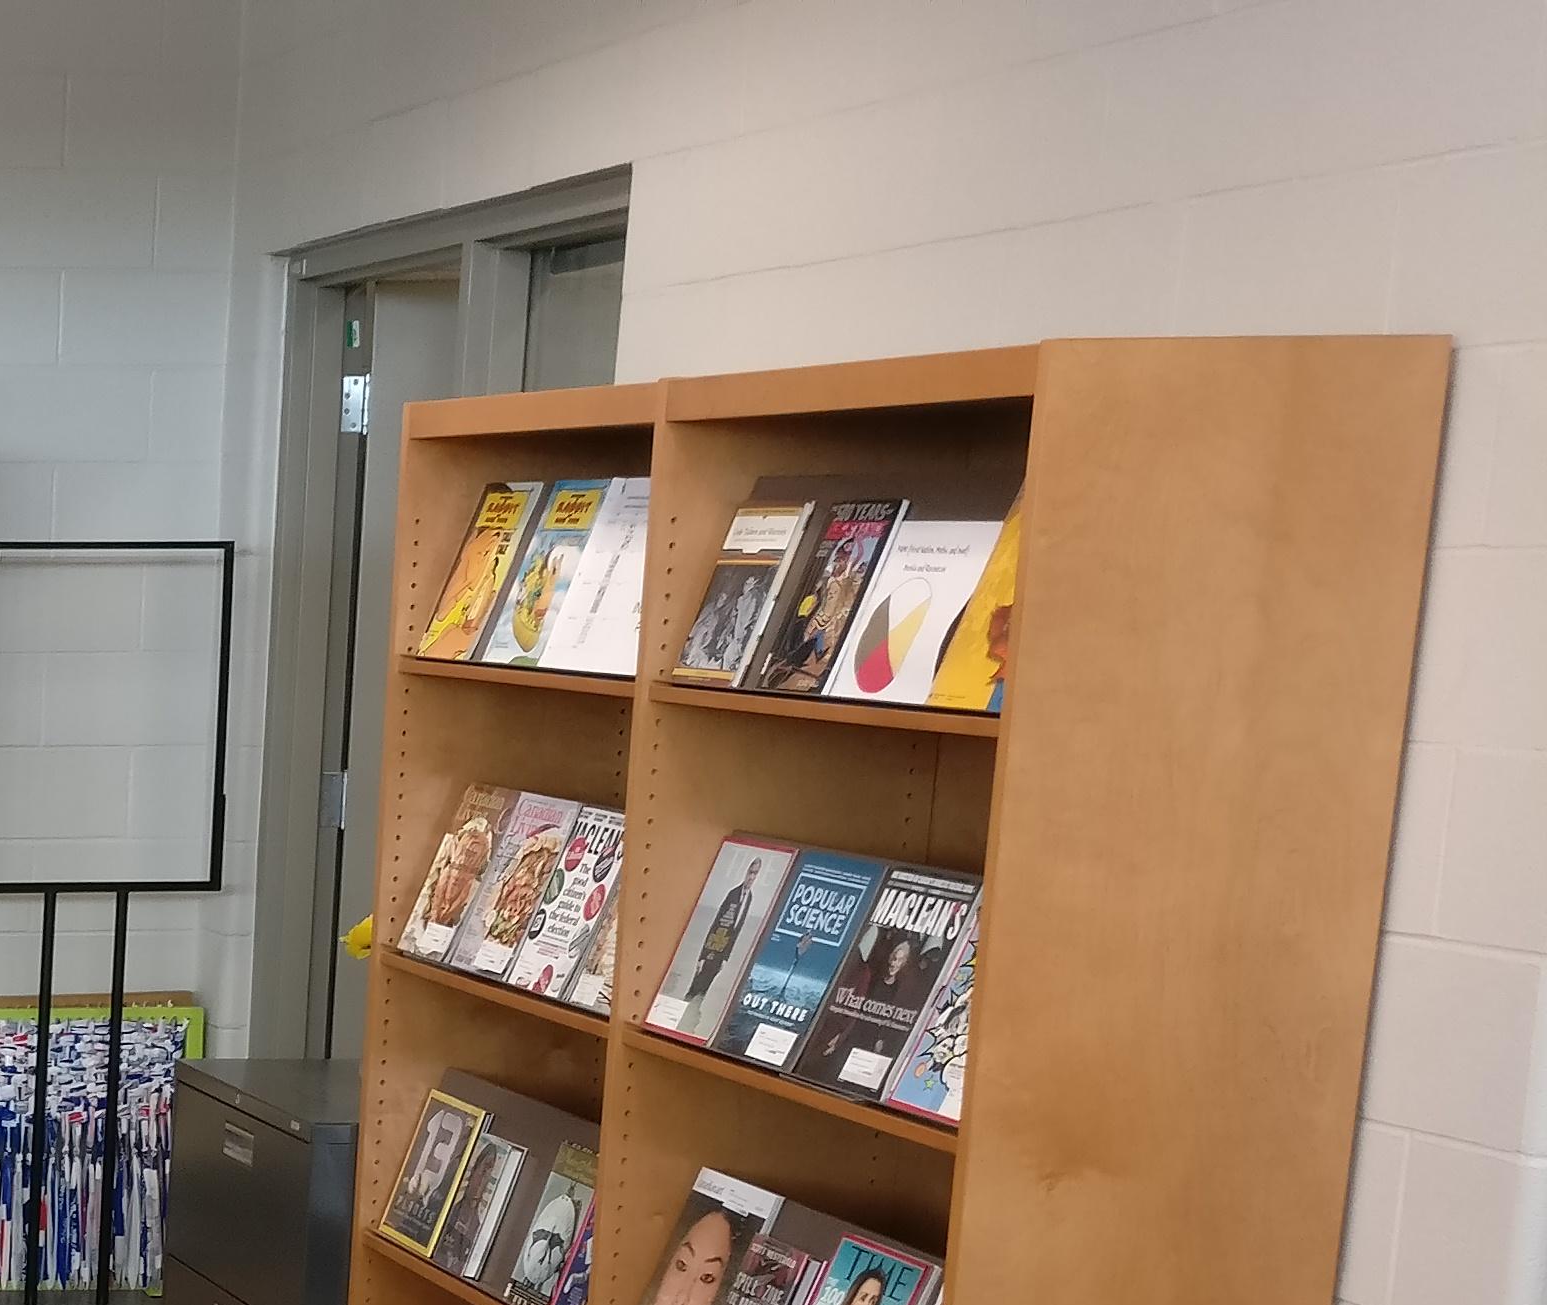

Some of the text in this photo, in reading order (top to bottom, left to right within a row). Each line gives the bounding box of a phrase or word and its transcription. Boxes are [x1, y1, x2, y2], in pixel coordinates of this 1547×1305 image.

[519, 799, 564, 824] Canadian
[580, 863, 591, 874] The
[572, 877, 589, 890] good
[557, 900, 575, 913] guide
[792, 883, 856, 917] POPULAR
[549, 910, 580, 927] the federal
[786, 903, 847, 937] SCIENCE
[869, 887, 968, 940] MACLEAN'S
[548, 922, 572, 938] election
[743, 993, 767, 1012] OUT
[770, 1000, 808, 1023] THERE
[834, 987, 863, 1010] What
[863, 998, 893, 1018] comes
